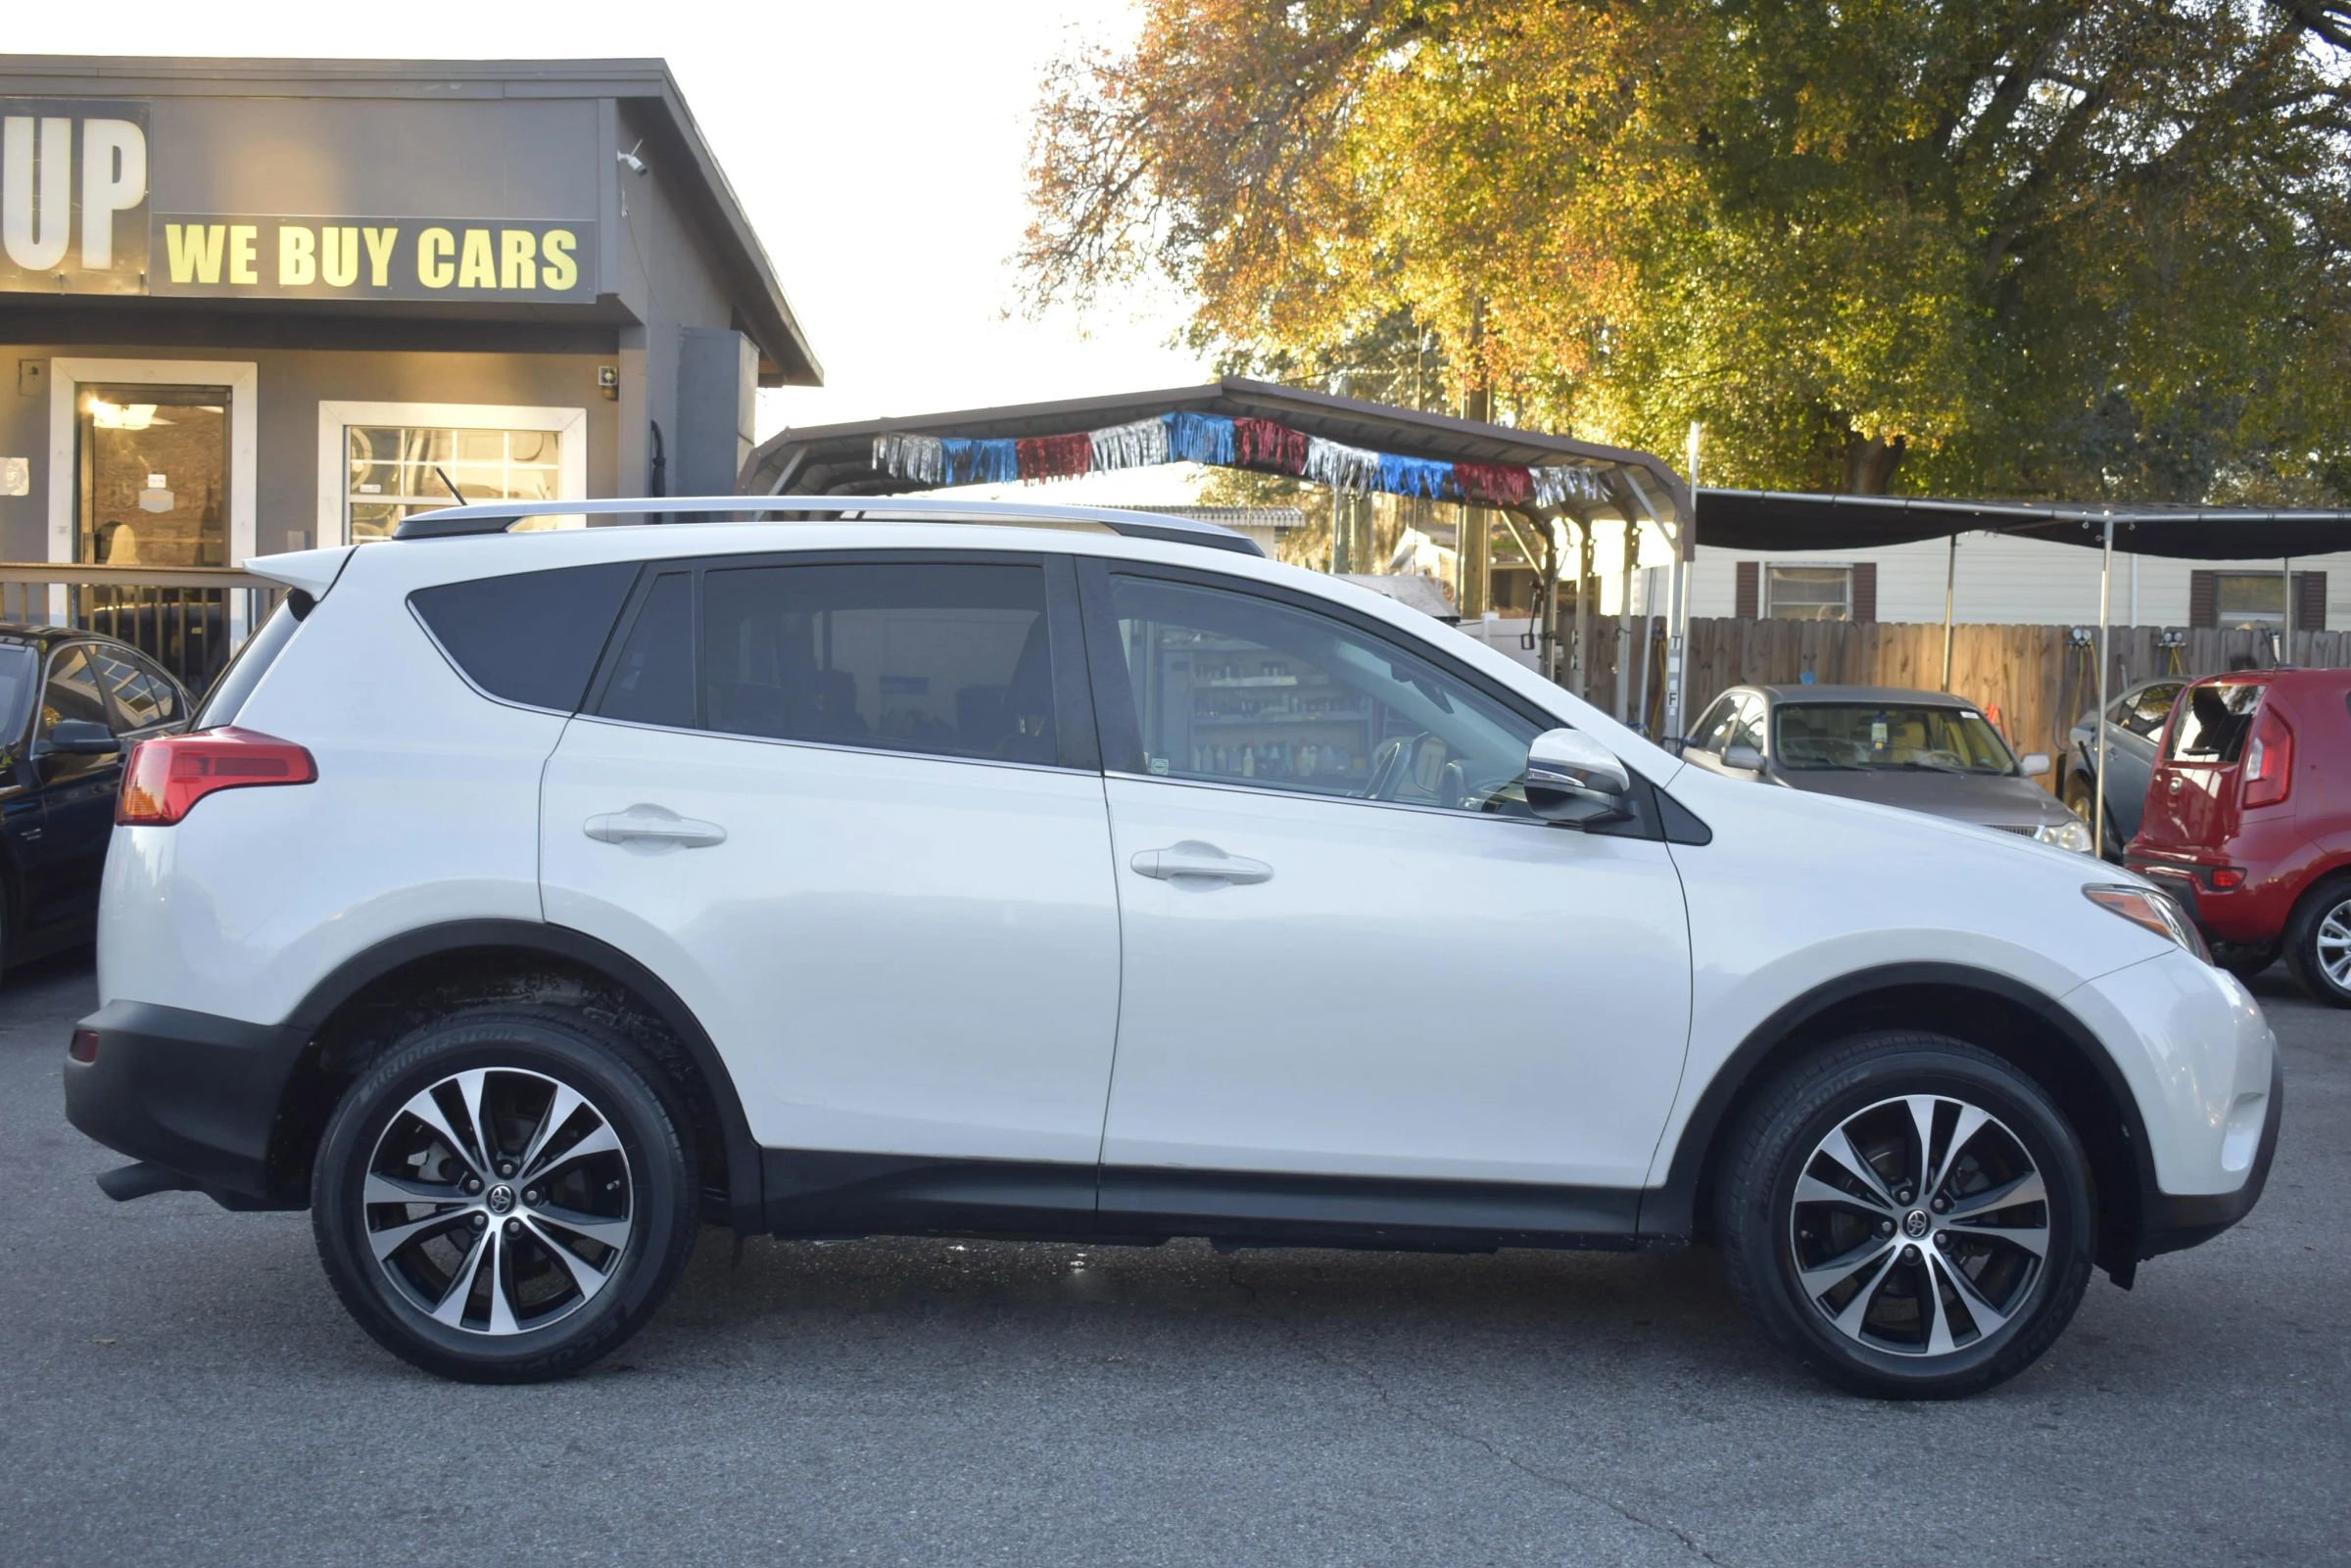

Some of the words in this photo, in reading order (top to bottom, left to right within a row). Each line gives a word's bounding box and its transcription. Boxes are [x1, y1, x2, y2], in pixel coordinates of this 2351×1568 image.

[3, 116, 146, 271] UP
[166, 223, 259, 285] WE
[278, 225, 398, 287] BUY
[417, 227, 578, 290] CARS
[1669, 692, 1677, 705] F
